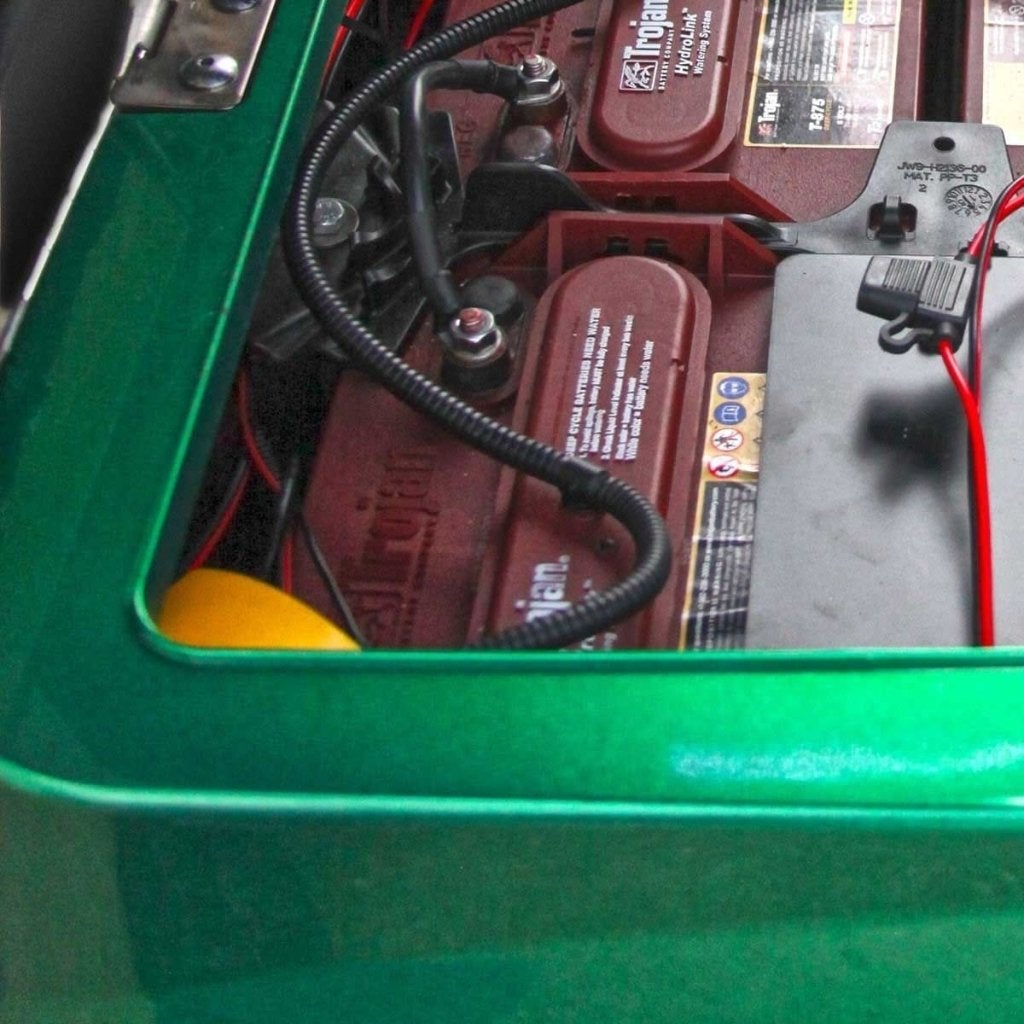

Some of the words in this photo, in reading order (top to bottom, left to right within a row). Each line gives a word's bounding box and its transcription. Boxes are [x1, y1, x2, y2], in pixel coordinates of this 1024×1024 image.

[699, 10, 713, 39] System
[693, 40, 710, 75] Watering
[918, 184, 928, 193] 2
[587, 307, 601, 336] WATER
[583, 337, 596, 359] NEED
[574, 360, 592, 405] BATTERIES
[568, 406, 583, 434] CYCLE
